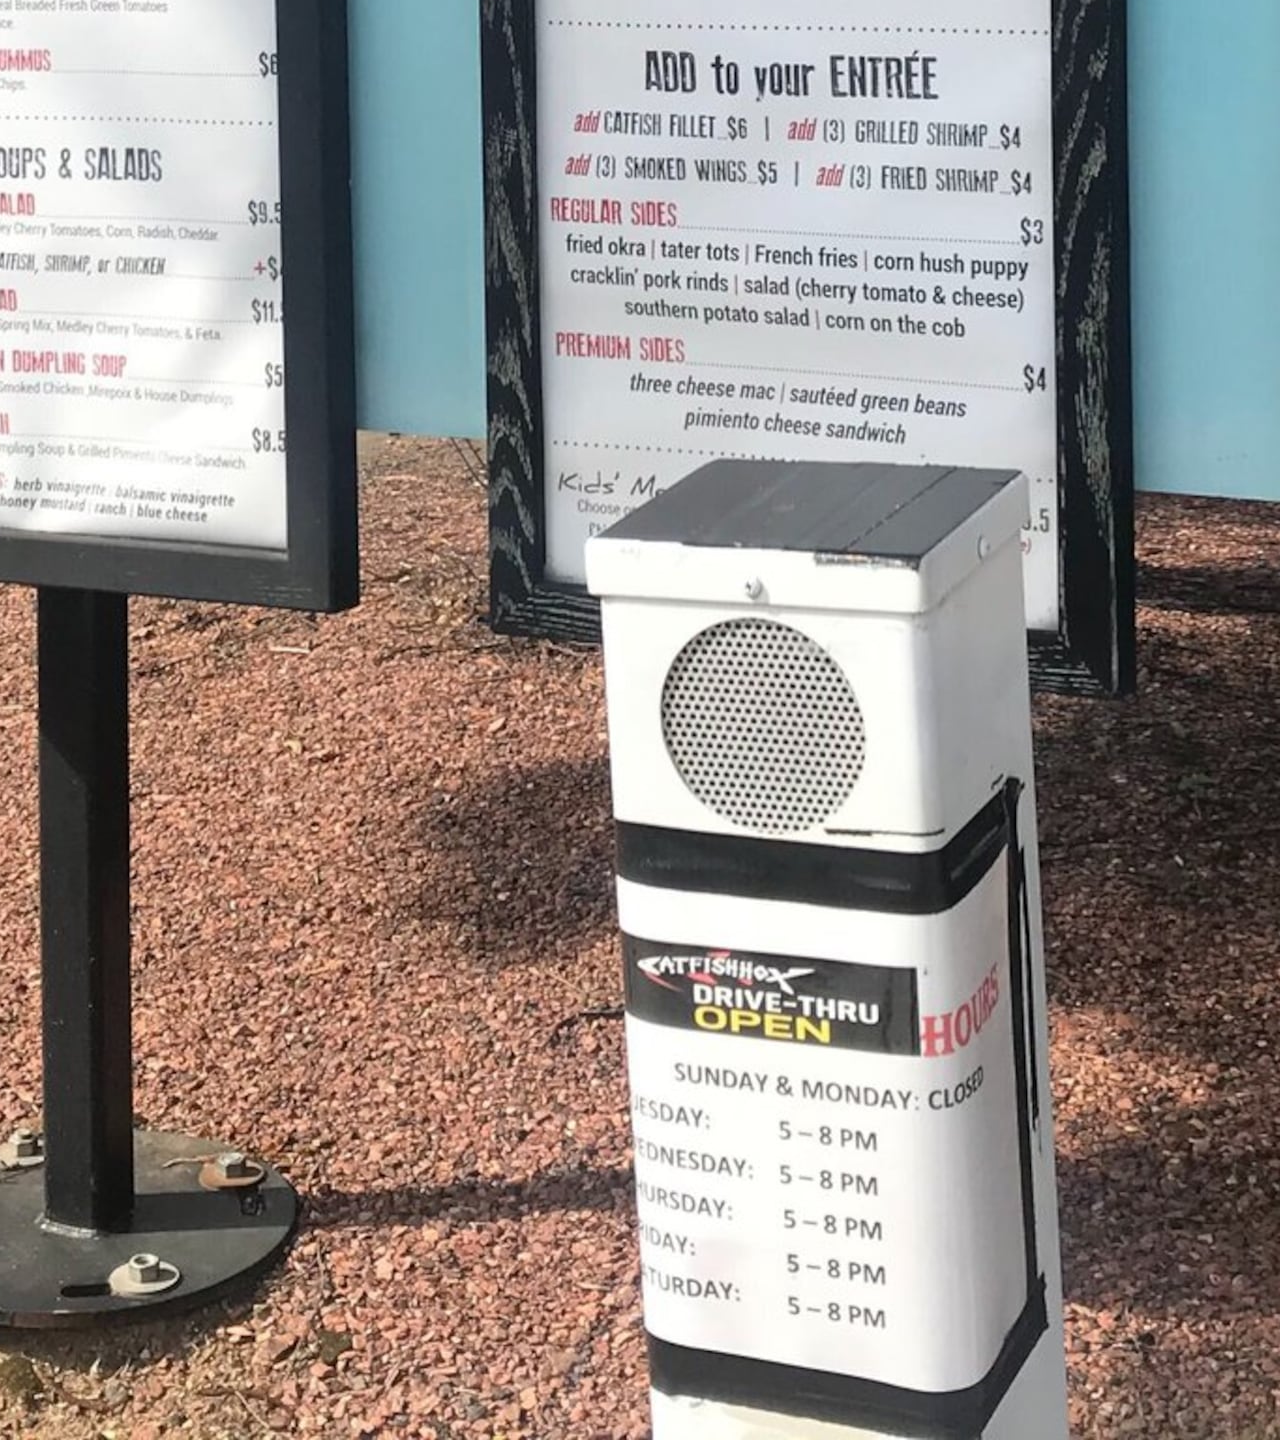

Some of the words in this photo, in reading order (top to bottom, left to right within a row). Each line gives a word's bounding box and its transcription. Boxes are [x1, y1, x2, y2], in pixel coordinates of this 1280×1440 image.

[646, 51, 696, 93] ADD
[711, 59, 739, 95] to
[754, 63, 815, 101] your
[830, 50, 938, 99] ENTRÉE
[59, 148, 72, 179] &
[85, 147, 162, 182] SALADS
[550, 197, 622, 224] REGULAR
[631, 201, 676, 227] SIDES
[1021, 217, 1043, 246] $3
[566, 233, 603, 254] fried
[608, 236, 645, 256] okra
[661, 241, 701, 259] tater
[706, 243, 739, 261] tots
[755, 244, 812, 266] French
[819, 247, 858, 268] fries
[874, 255, 914, 271] corn
[920, 252, 964, 273] hush
[971, 260, 1028, 281] puppy
[12, 350, 85, 374] DUMPLING
[93, 354, 127, 378] SOUP
[555, 332, 630, 360] PREMIUM
[640, 337, 685, 362] SIDES
[1024, 364, 1046, 393] $4
[693, 985, 879, 1024] DRIVE-THRU
[922, 965, 999, 1057] HOURS
[694, 1007, 830, 1043] OPEN
[674, 1064, 768, 1096] SUNDAY
[777, 1077, 793, 1096] &
[802, 1079, 920, 1110] MONDAY:
[928, 1066, 984, 1110] CLOSED
[779, 1121, 791, 1140] 5
[820, 1126, 832, 1145] 8
[841, 1129, 877, 1151] PM
[780, 1165, 792, 1184] 5
[820, 1170, 832, 1189] 8
[841, 1173, 878, 1196] PM
[783, 1209, 796, 1229] 5
[824, 1215, 836, 1234] 8
[845, 1217, 882, 1240] PM
[787, 1254, 799, 1273] 5
[828, 1260, 840, 1278] 8
[849, 1262, 885, 1285] PM
[788, 1297, 800, 1315] 5
[828, 1303, 841, 1321] 8
[849, 1305, 885, 1328] PM
